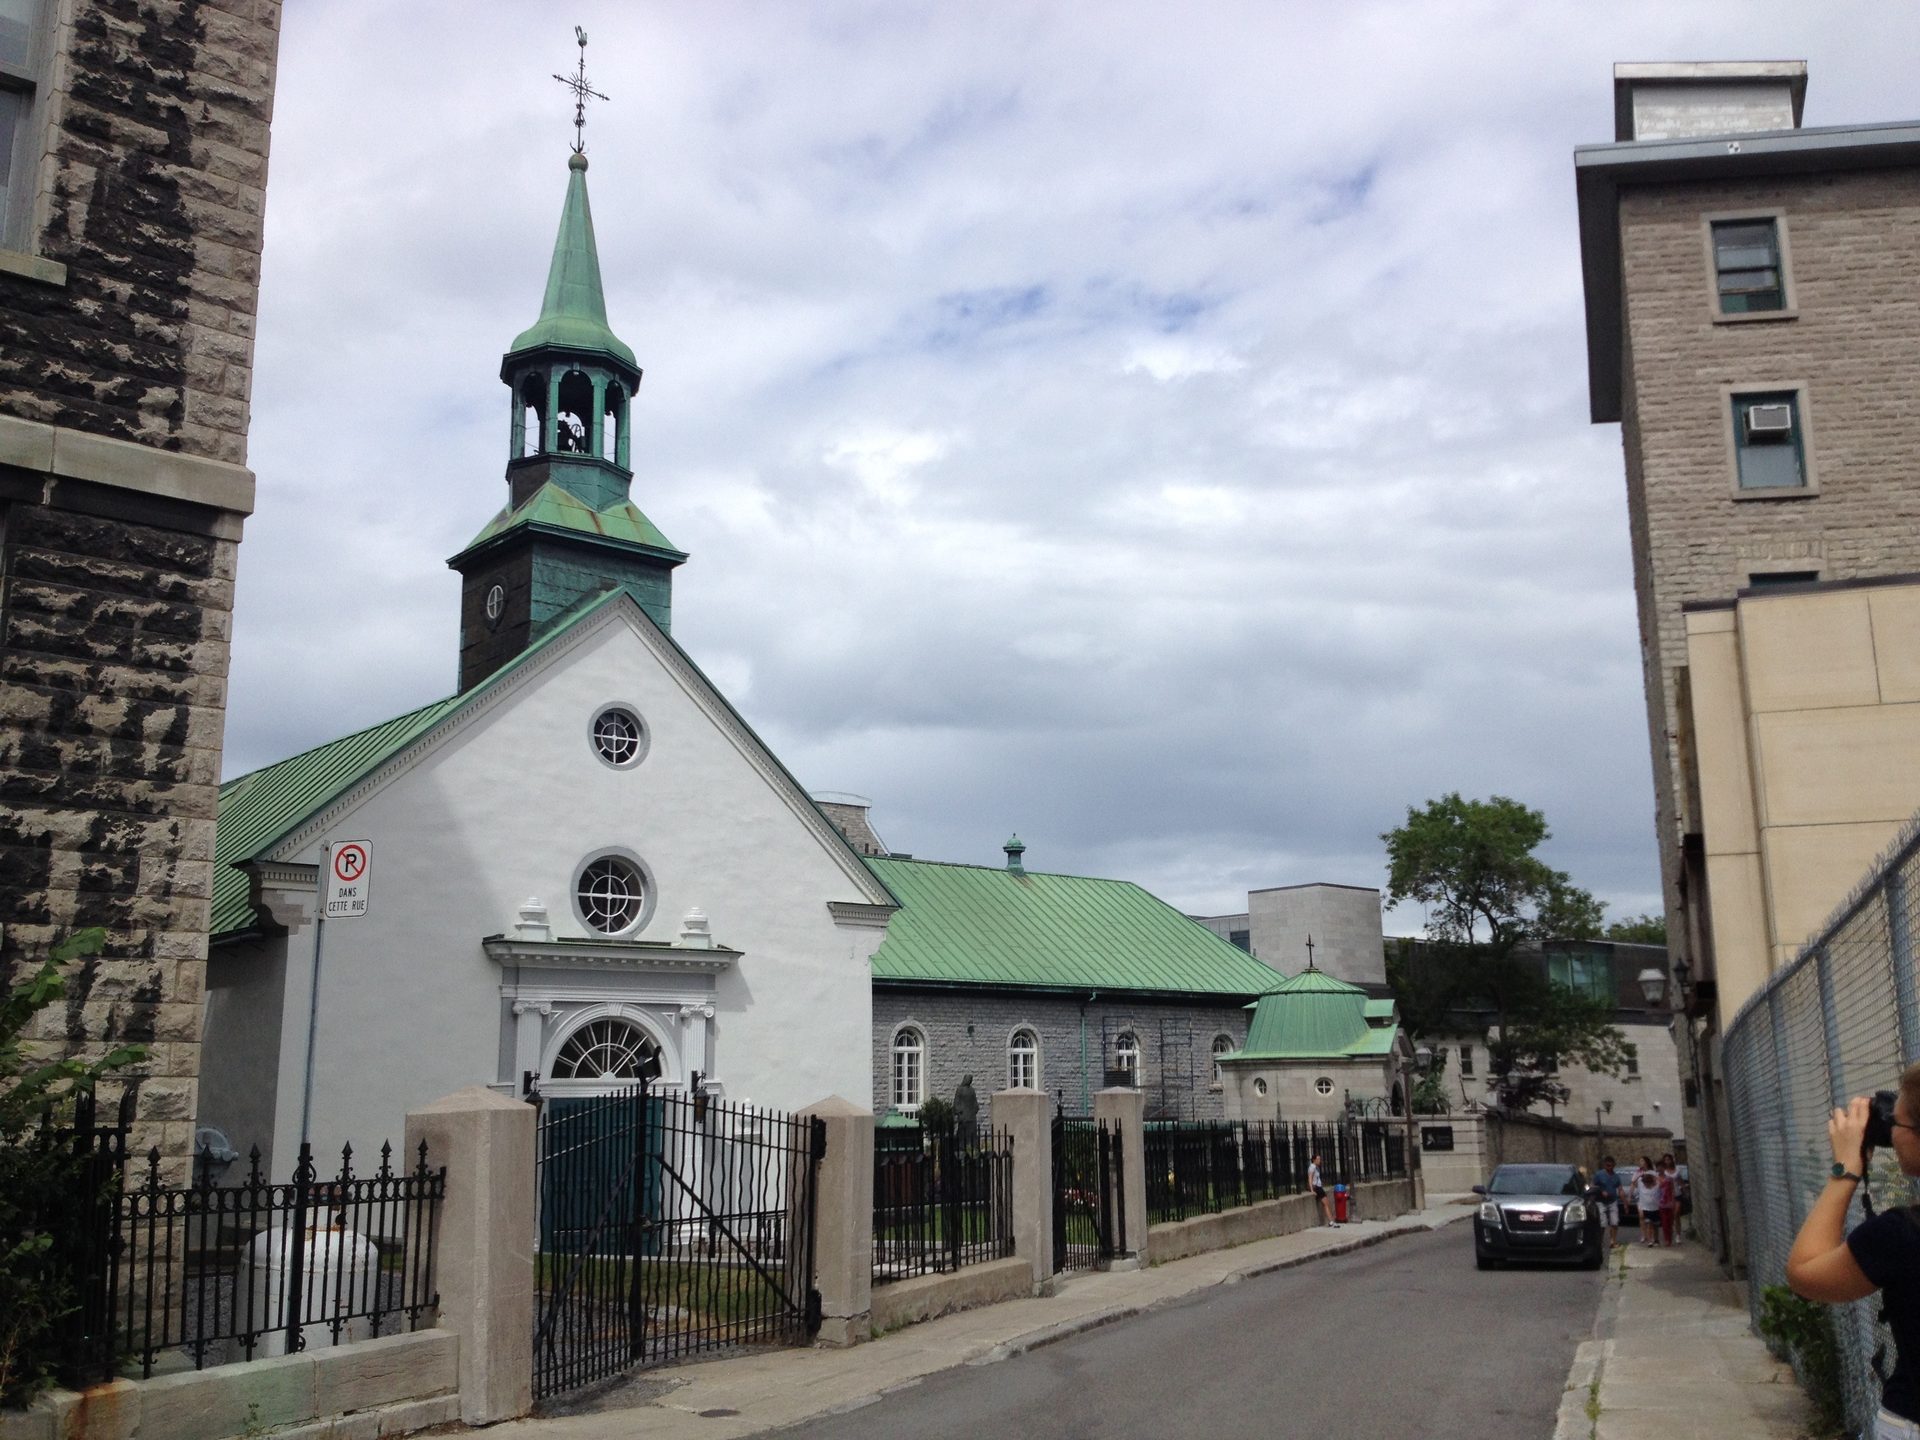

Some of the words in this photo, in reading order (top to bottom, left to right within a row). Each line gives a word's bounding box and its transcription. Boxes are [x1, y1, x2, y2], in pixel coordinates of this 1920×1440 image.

[345, 853, 357, 873] P
[339, 887, 357, 898] DANS
[328, 901, 348, 912] CETTE
[352, 900, 365, 910] RUE
[1519, 1214, 1545, 1222] GMC
